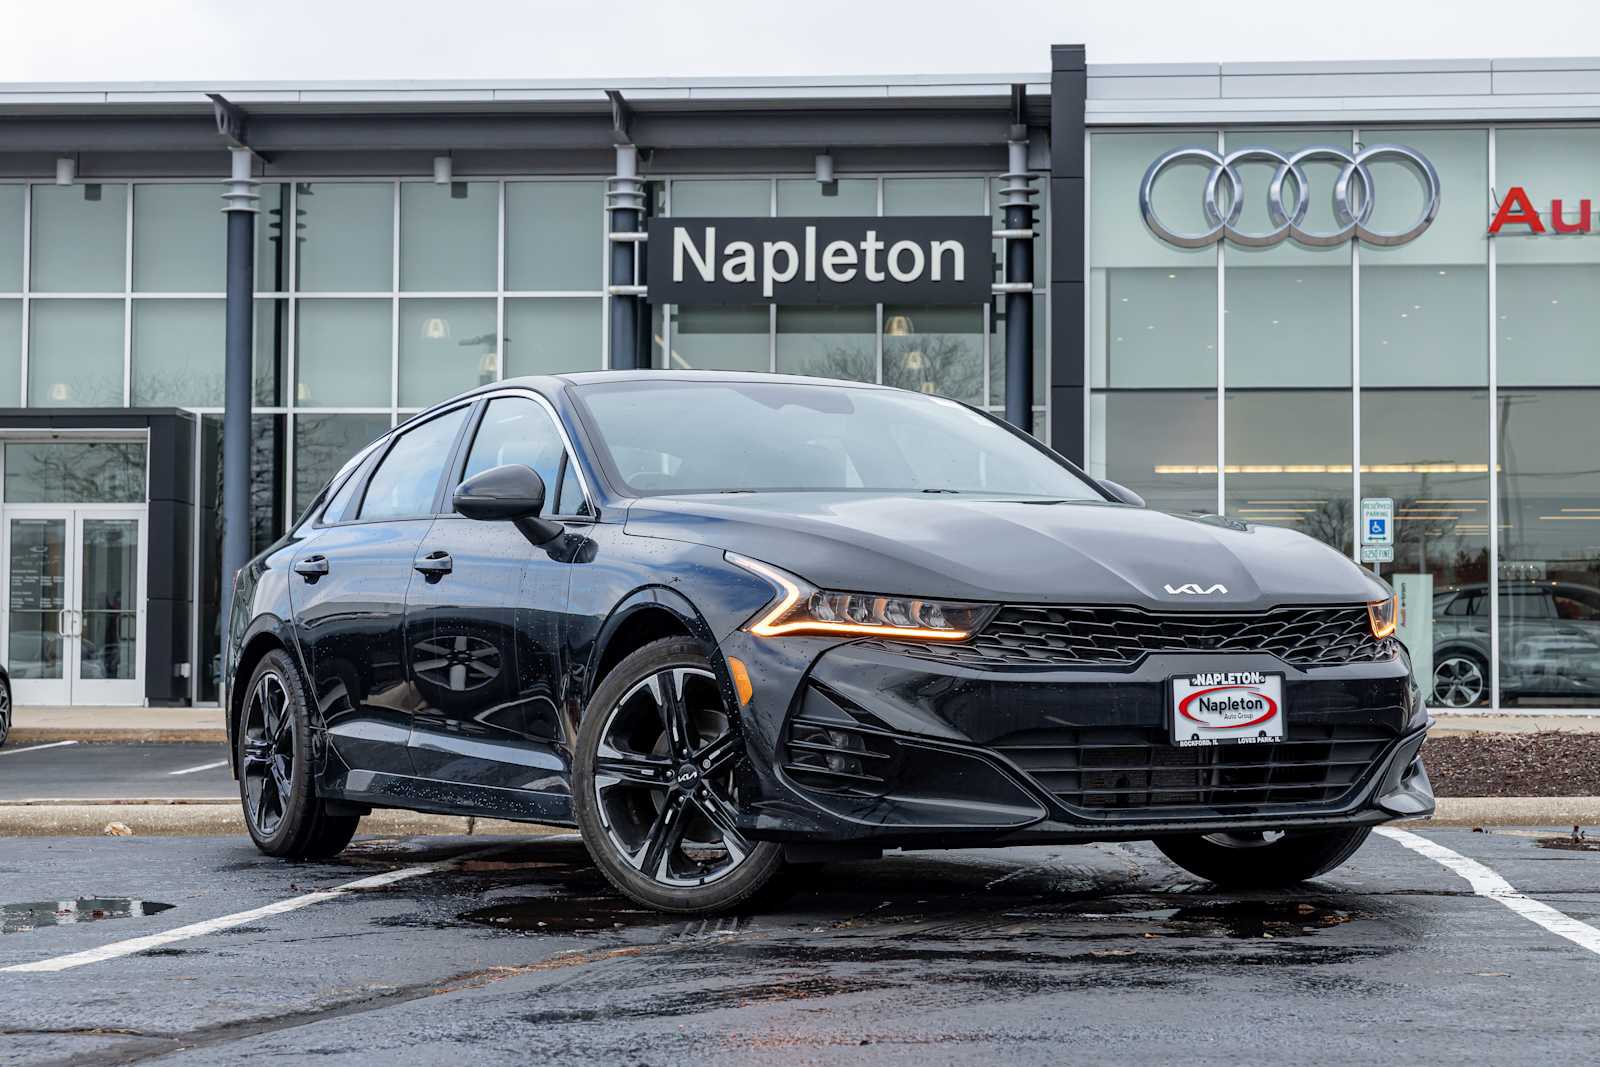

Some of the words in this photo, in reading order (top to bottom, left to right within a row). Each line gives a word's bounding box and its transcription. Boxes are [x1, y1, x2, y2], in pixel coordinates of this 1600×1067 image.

[673, 226, 965, 297] Napleton
[1163, 583, 1228, 595] KIA
[1197, 672, 1260, 686] NAPLETON
[1199, 696, 1263, 714] Napleton
[1224, 712, 1237, 720] Auto
[1238, 712, 1254, 720] Group
